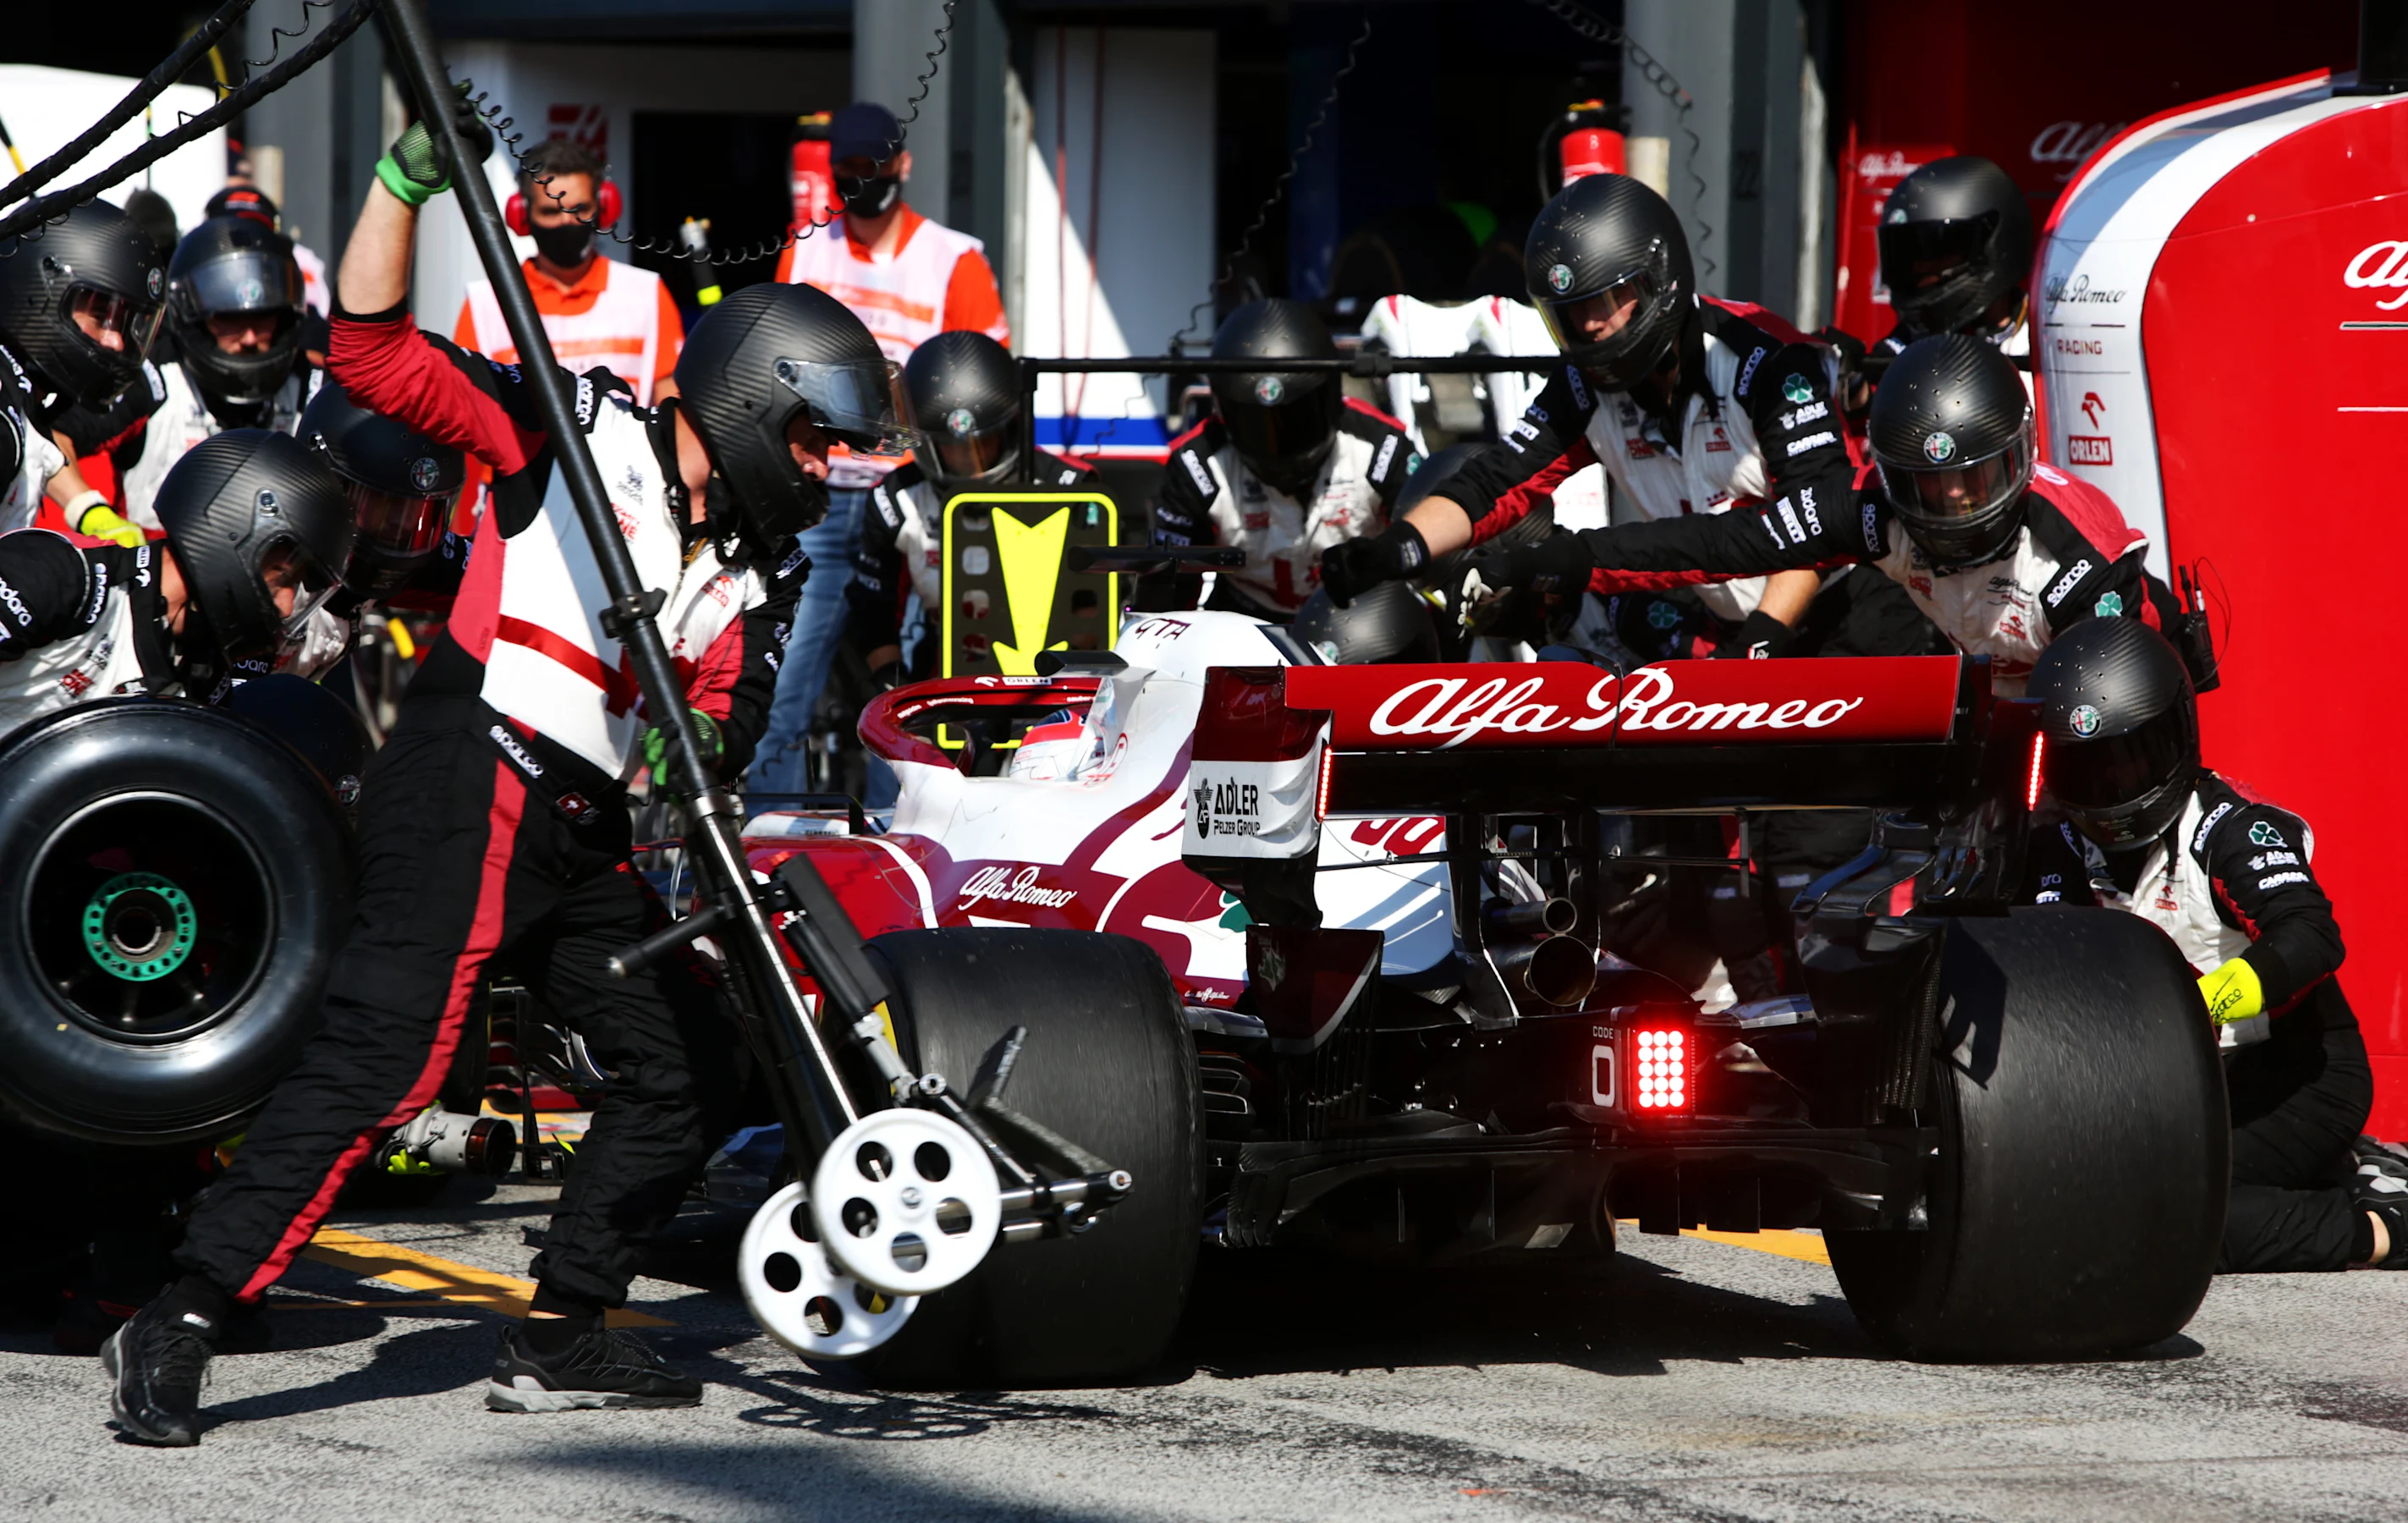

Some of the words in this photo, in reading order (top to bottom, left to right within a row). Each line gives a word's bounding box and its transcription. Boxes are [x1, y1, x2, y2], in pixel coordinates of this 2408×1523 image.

[2045, 272, 2068, 315] Alfa
[2070, 274, 2126, 304] Romeo
[2057, 339, 2103, 355] RACING
[1738, 346, 1767, 396] sparco
[2070, 439, 2111, 463] ORLEN
[86, 562, 107, 624] sparco
[2047, 559, 2092, 608] sparco
[1135, 618, 1192, 640] GTA
[1369, 678, 1572, 749] Alfa
[1570, 668, 1864, 732] Romeo
[489, 725, 544, 778] sparco
[1214, 783, 1259, 816] ADLER
[2194, 802, 2233, 853] sparco
[958, 866, 1006, 910] Alfa
[1003, 866, 1078, 909] Romeo
[1592, 1025, 1614, 1039] CODE
[1592, 1044, 1615, 1108] 0
